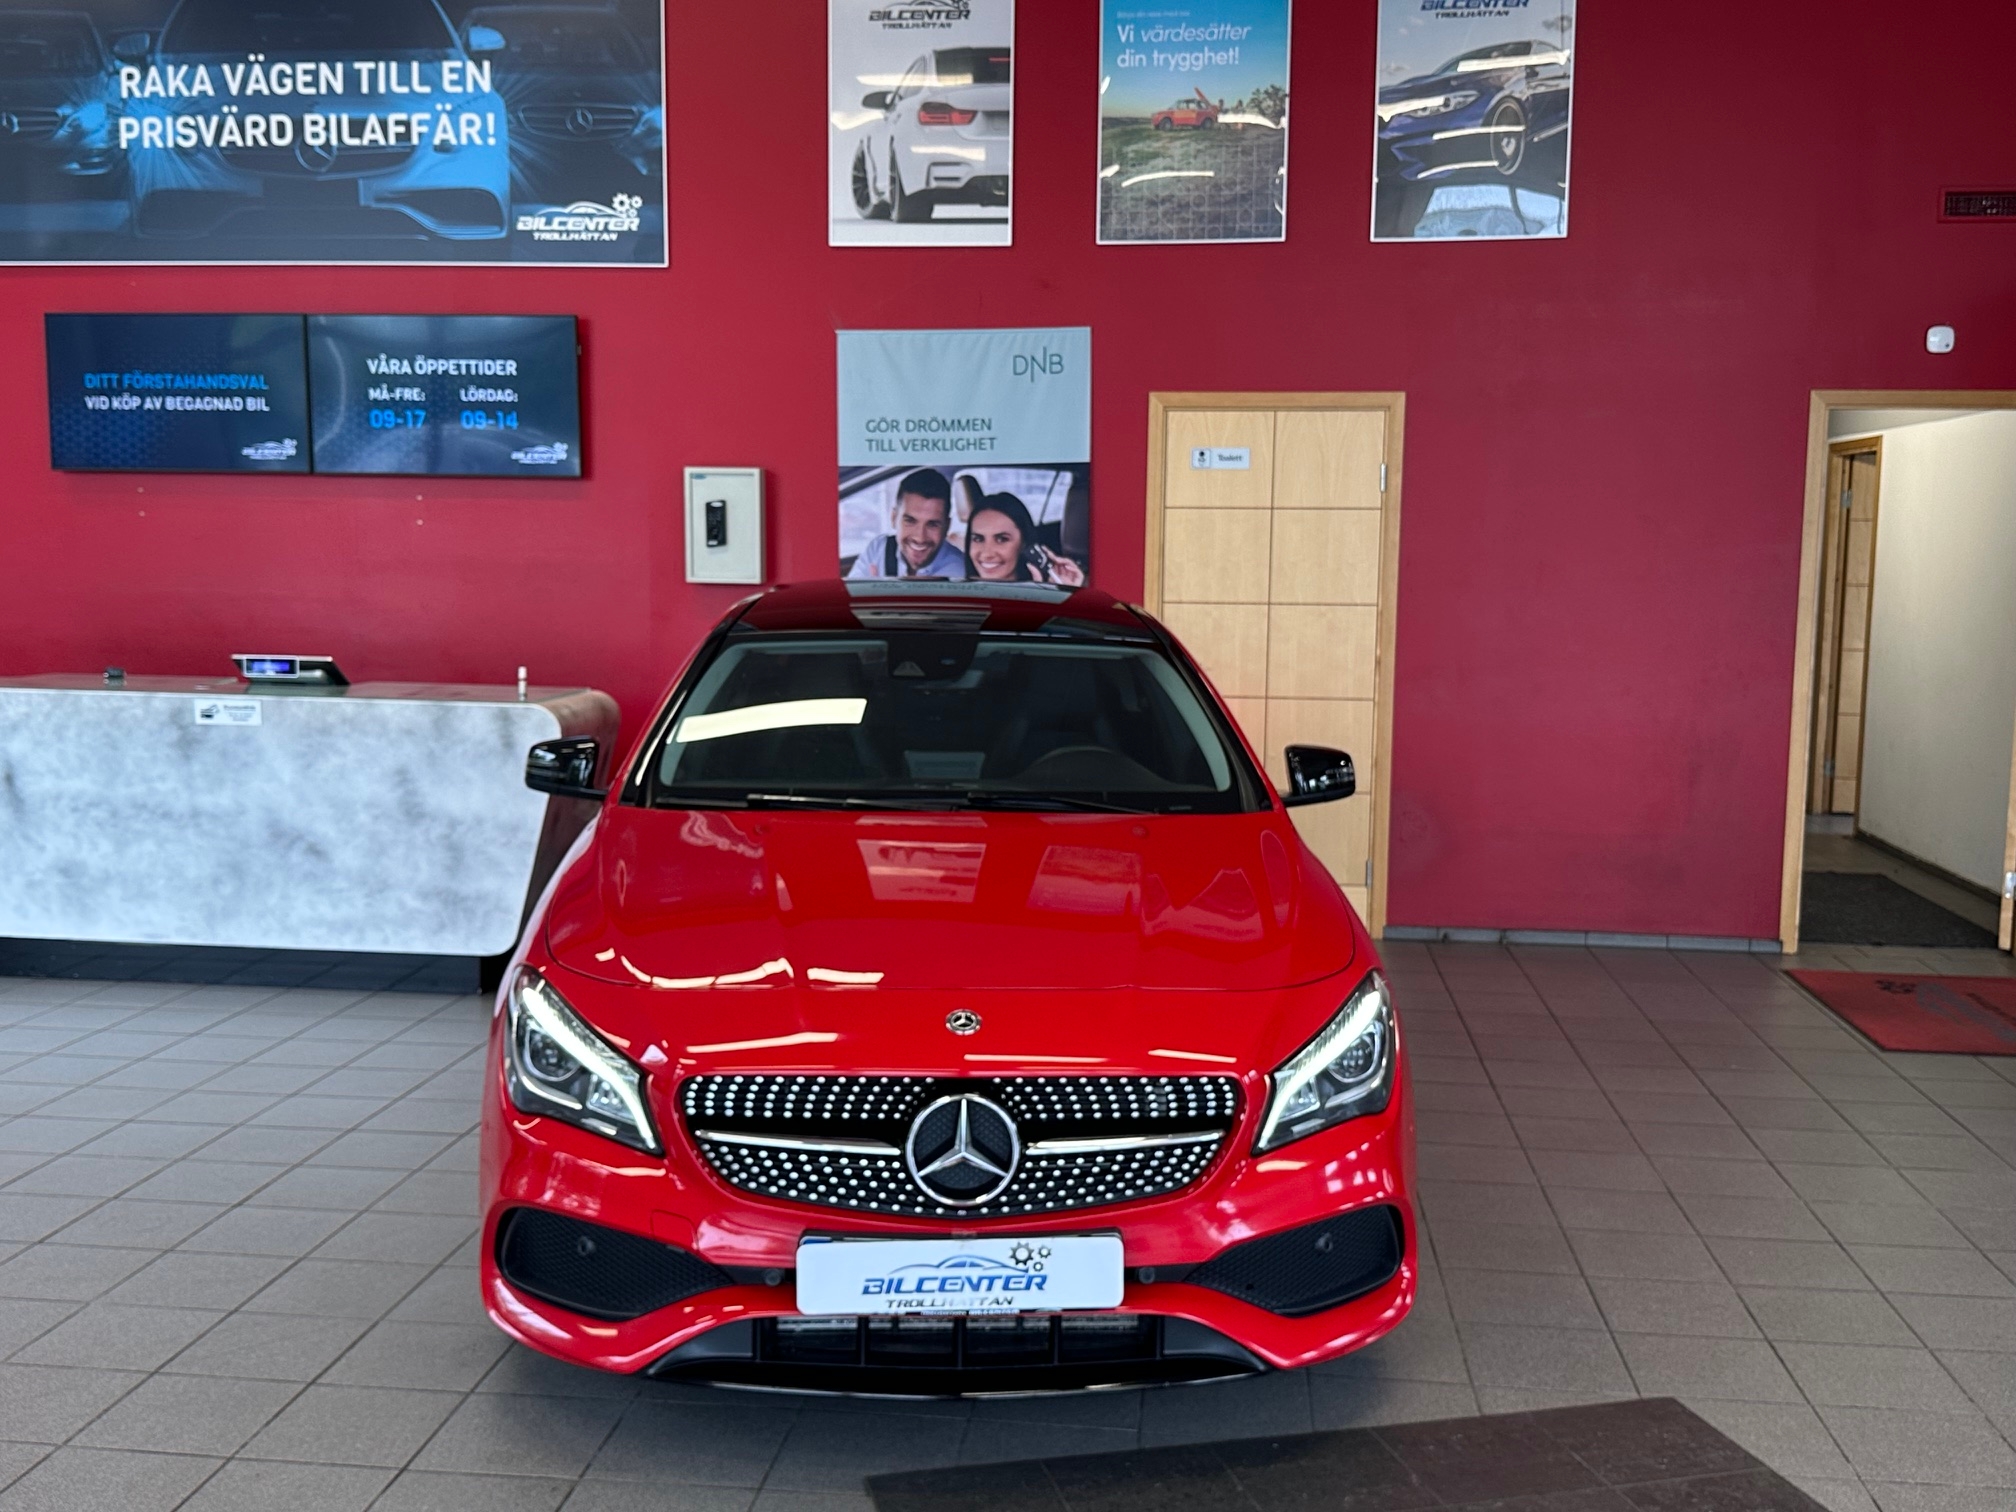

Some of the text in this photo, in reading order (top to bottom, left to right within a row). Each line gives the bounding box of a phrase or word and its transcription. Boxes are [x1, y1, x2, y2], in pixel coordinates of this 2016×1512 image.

[869, 9, 972, 21] BILCENTER
[1117, 23, 1251, 43] Vi värdesätter
[1117, 47, 1240, 71] din trygghet!
[119, 53, 492, 99] RAKA VÄGEN TILL EN
[118, 102, 497, 150] PRISVÄRD BILAFFÄR!
[516, 215, 640, 231] BILCENTER
[366, 353, 518, 376] VÅRA ÖPPETTIDER
[1012, 346, 1065, 383] DNB
[83, 369, 270, 390] DITT FÖRSTAHANDSVAL
[84, 395, 110, 410] VID
[111, 391, 141, 411] KÖP
[143, 396, 162, 410] AV
[246, 396, 271, 412] BIL
[367, 383, 426, 402] MÅ-FRE:
[368, 408, 427, 430] 09-17
[459, 410, 519, 431] 09-14
[865, 416, 993, 434] GÖR DRÖMMEN
[865, 436, 998, 453] TILL VERKLIGHET
[862, 1274, 1048, 1296] BILCENTER
